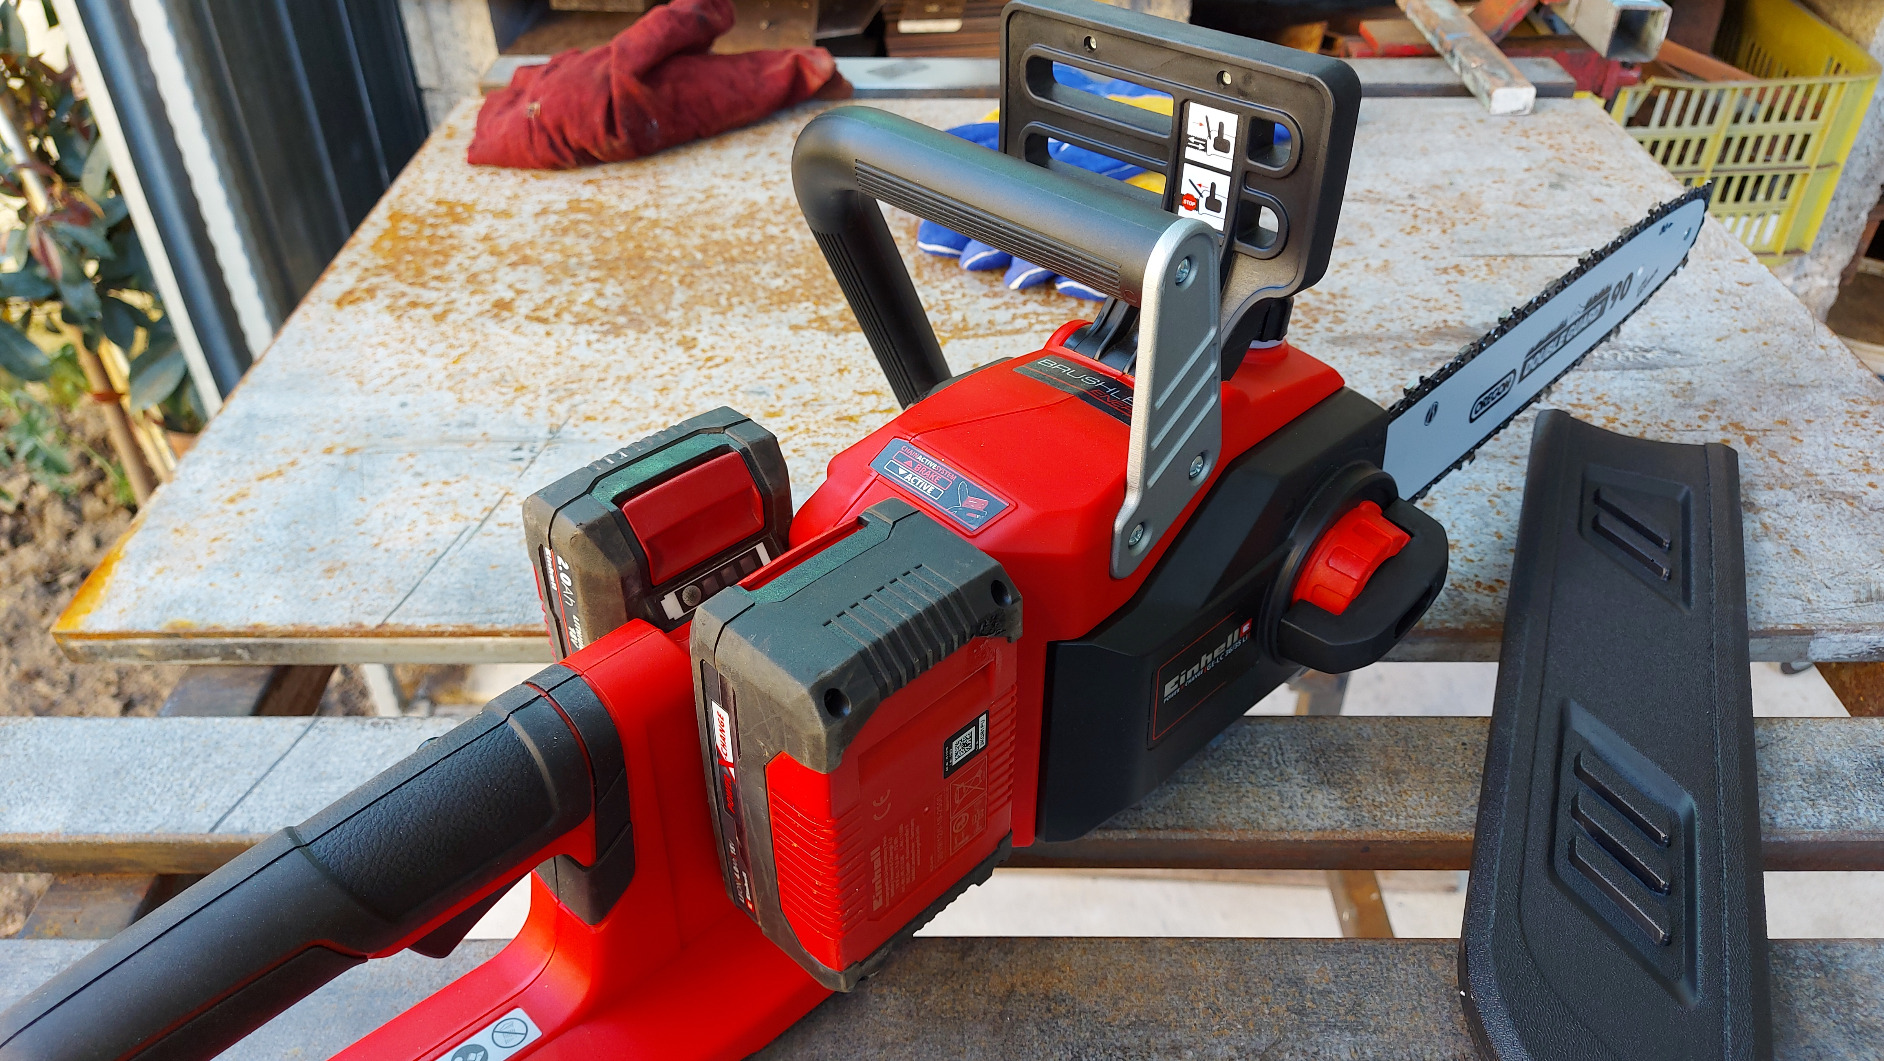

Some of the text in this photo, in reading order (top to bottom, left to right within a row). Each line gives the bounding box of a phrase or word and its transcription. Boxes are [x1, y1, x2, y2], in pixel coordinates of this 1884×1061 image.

[904, 473, 934, 494] ACTIVE
[914, 463, 942, 484] BRAKE
[1163, 627, 1240, 698] Einhell
[723, 773, 736, 815] POWER
[870, 845, 883, 911] Einhell
